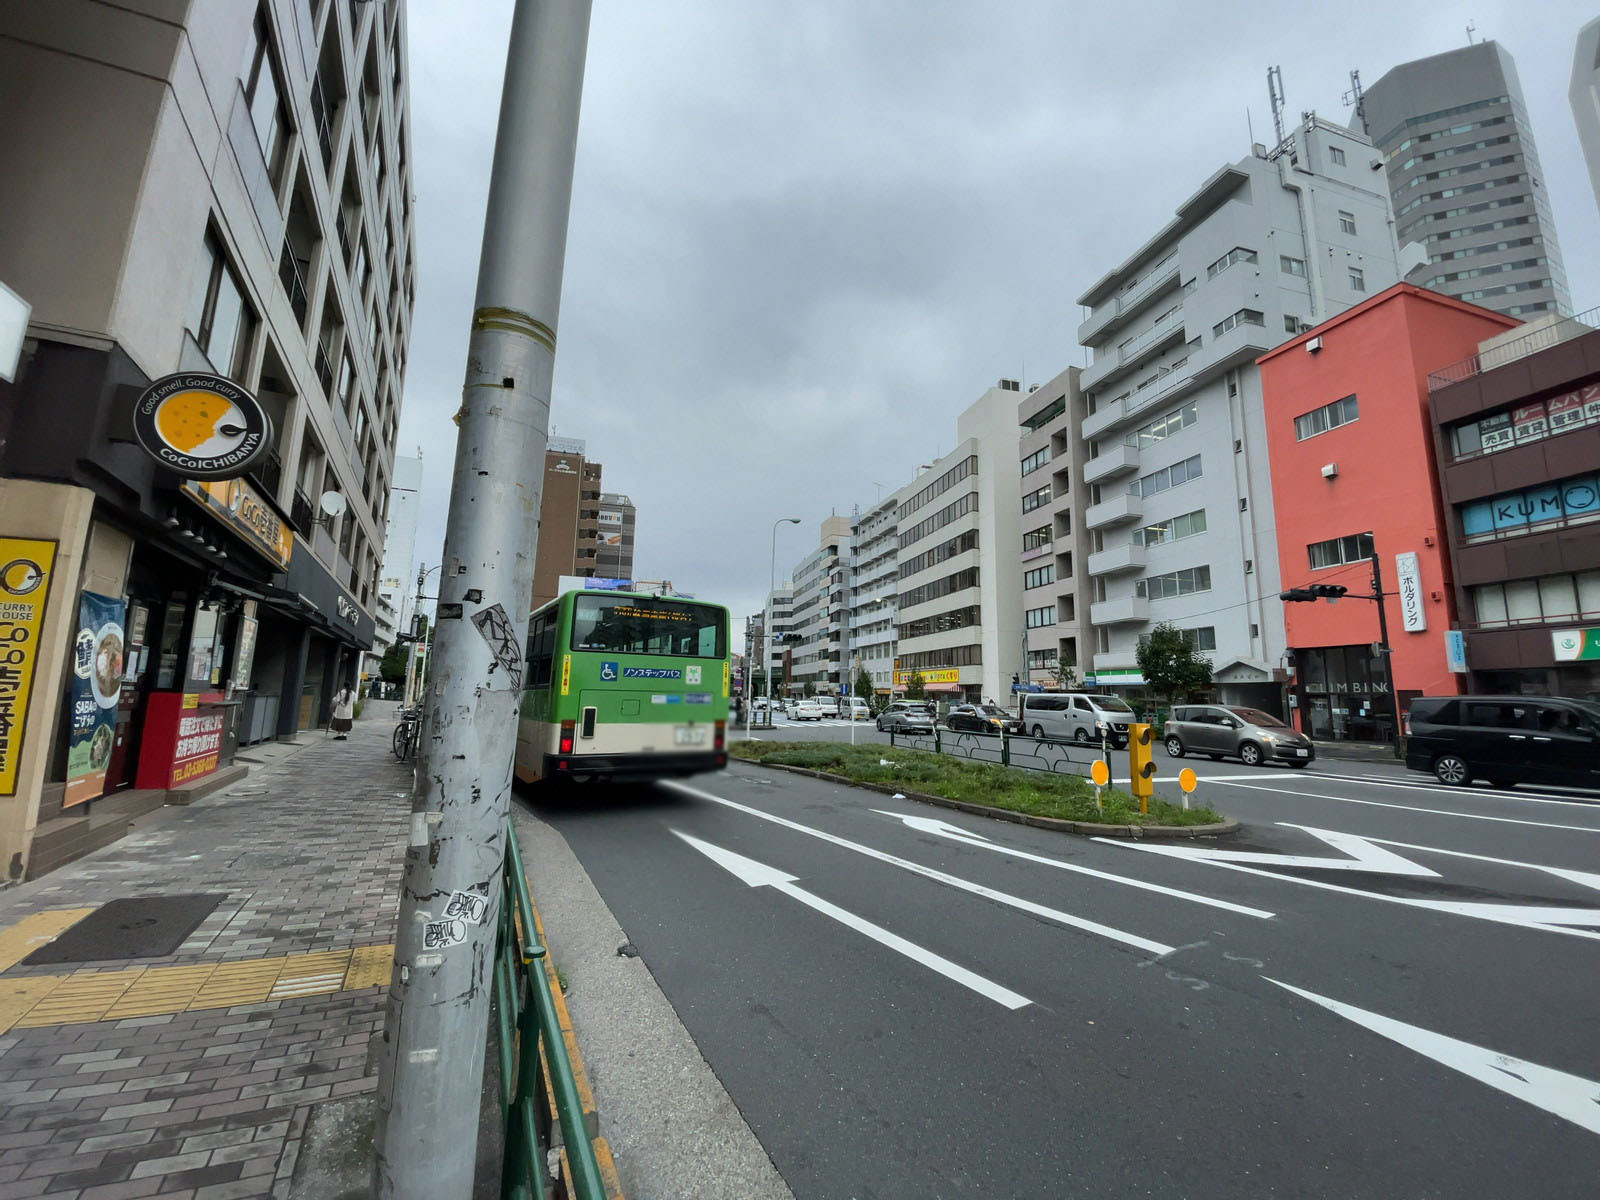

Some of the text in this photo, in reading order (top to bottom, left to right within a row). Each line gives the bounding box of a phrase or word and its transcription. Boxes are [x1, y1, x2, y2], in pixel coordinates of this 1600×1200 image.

[141, 378, 241, 415] Good smell. Good curry
[160, 432, 260, 469] CoCoICHIBANYA
[624, 668, 681, 679] ノンステップバス
